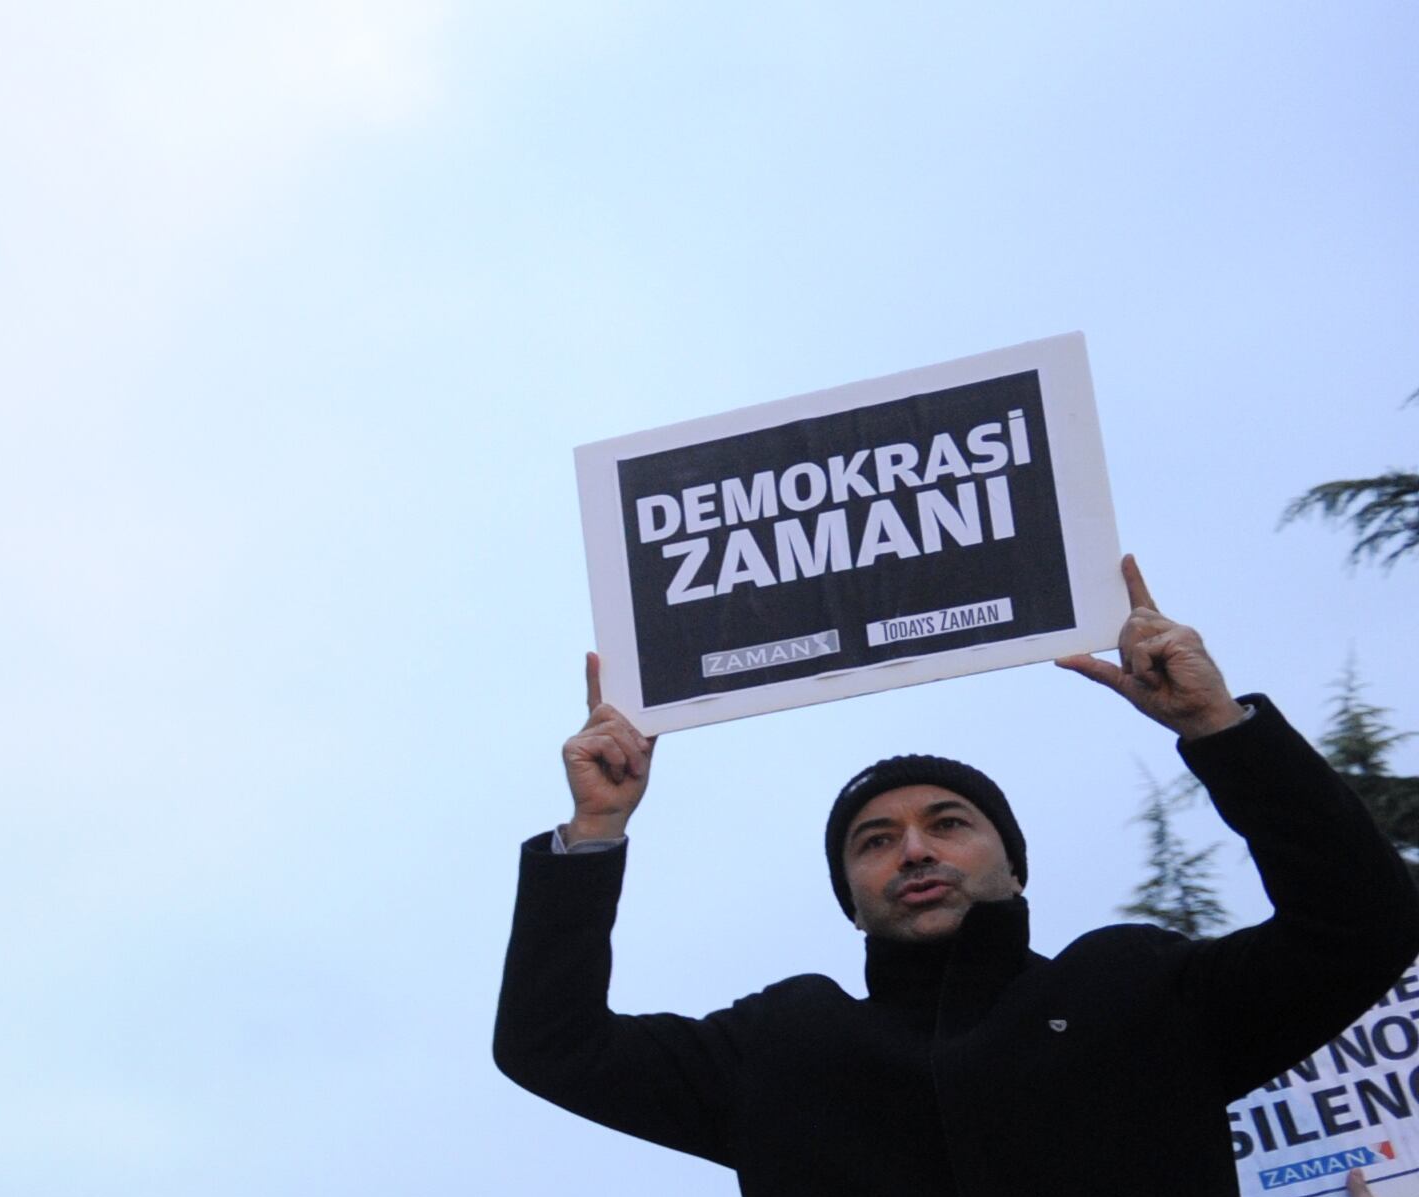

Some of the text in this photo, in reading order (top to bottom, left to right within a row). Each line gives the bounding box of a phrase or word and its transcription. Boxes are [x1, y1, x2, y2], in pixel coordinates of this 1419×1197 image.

[636, 408, 1031, 544] DEMOKRASİ
[662, 476, 1016, 606] ZAMANI
[939, 604, 999, 631] ZAMAN
[708, 640, 811, 673] ZAMAN
[1229, 1065, 1419, 1160] SILEN
[1265, 1150, 1366, 1187] ZAMAN
